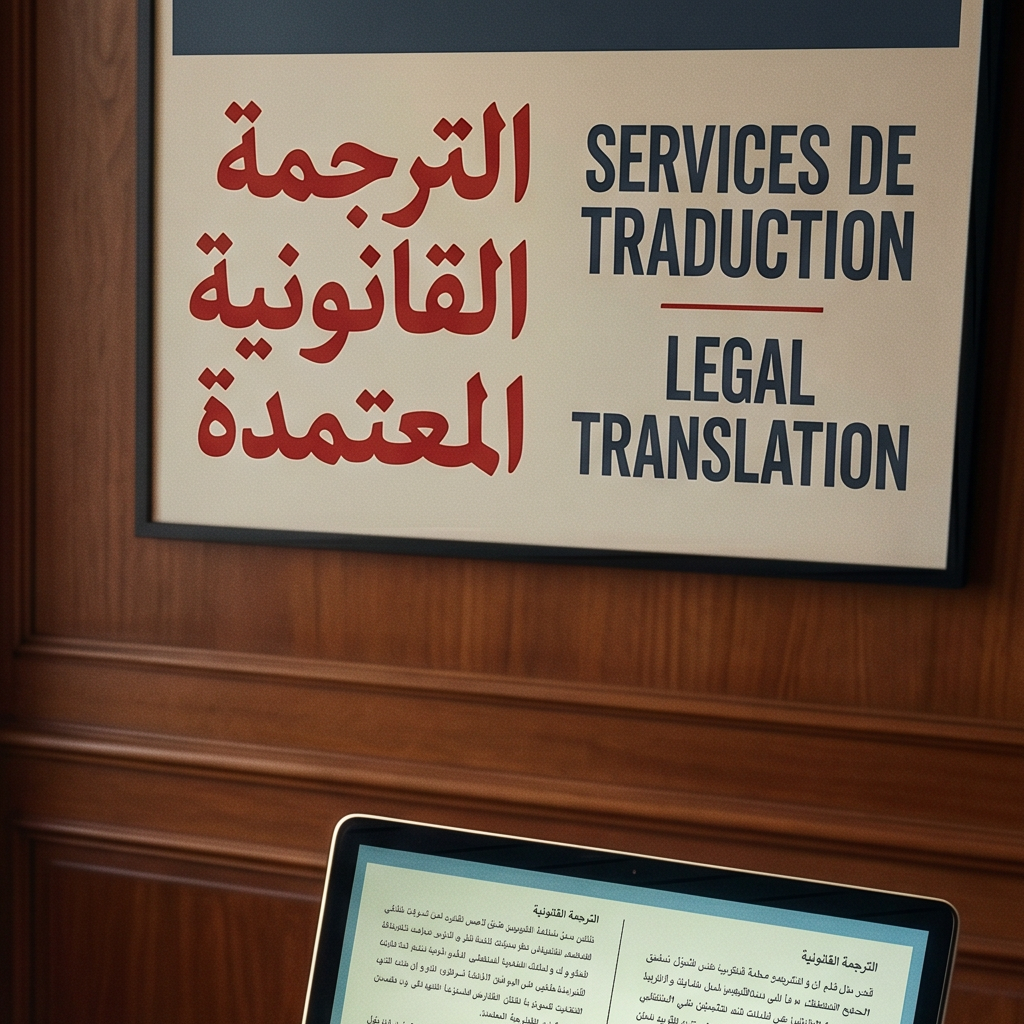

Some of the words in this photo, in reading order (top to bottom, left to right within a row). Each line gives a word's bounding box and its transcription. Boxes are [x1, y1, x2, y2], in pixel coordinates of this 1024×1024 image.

[216, 100, 532, 229] الترجمة
[584, 123, 831, 196] SERVICES
[848, 124, 918, 197] DE
[580, 205, 915, 283] TRADUCTION
[188, 232, 528, 364] القانونية
[665, 334, 817, 407] LEGAL
[197, 367, 525, 477] المعتمدة
[571, 410, 911, 493] TRANSLATION
[841, 955, 878, 974] الترجمة
